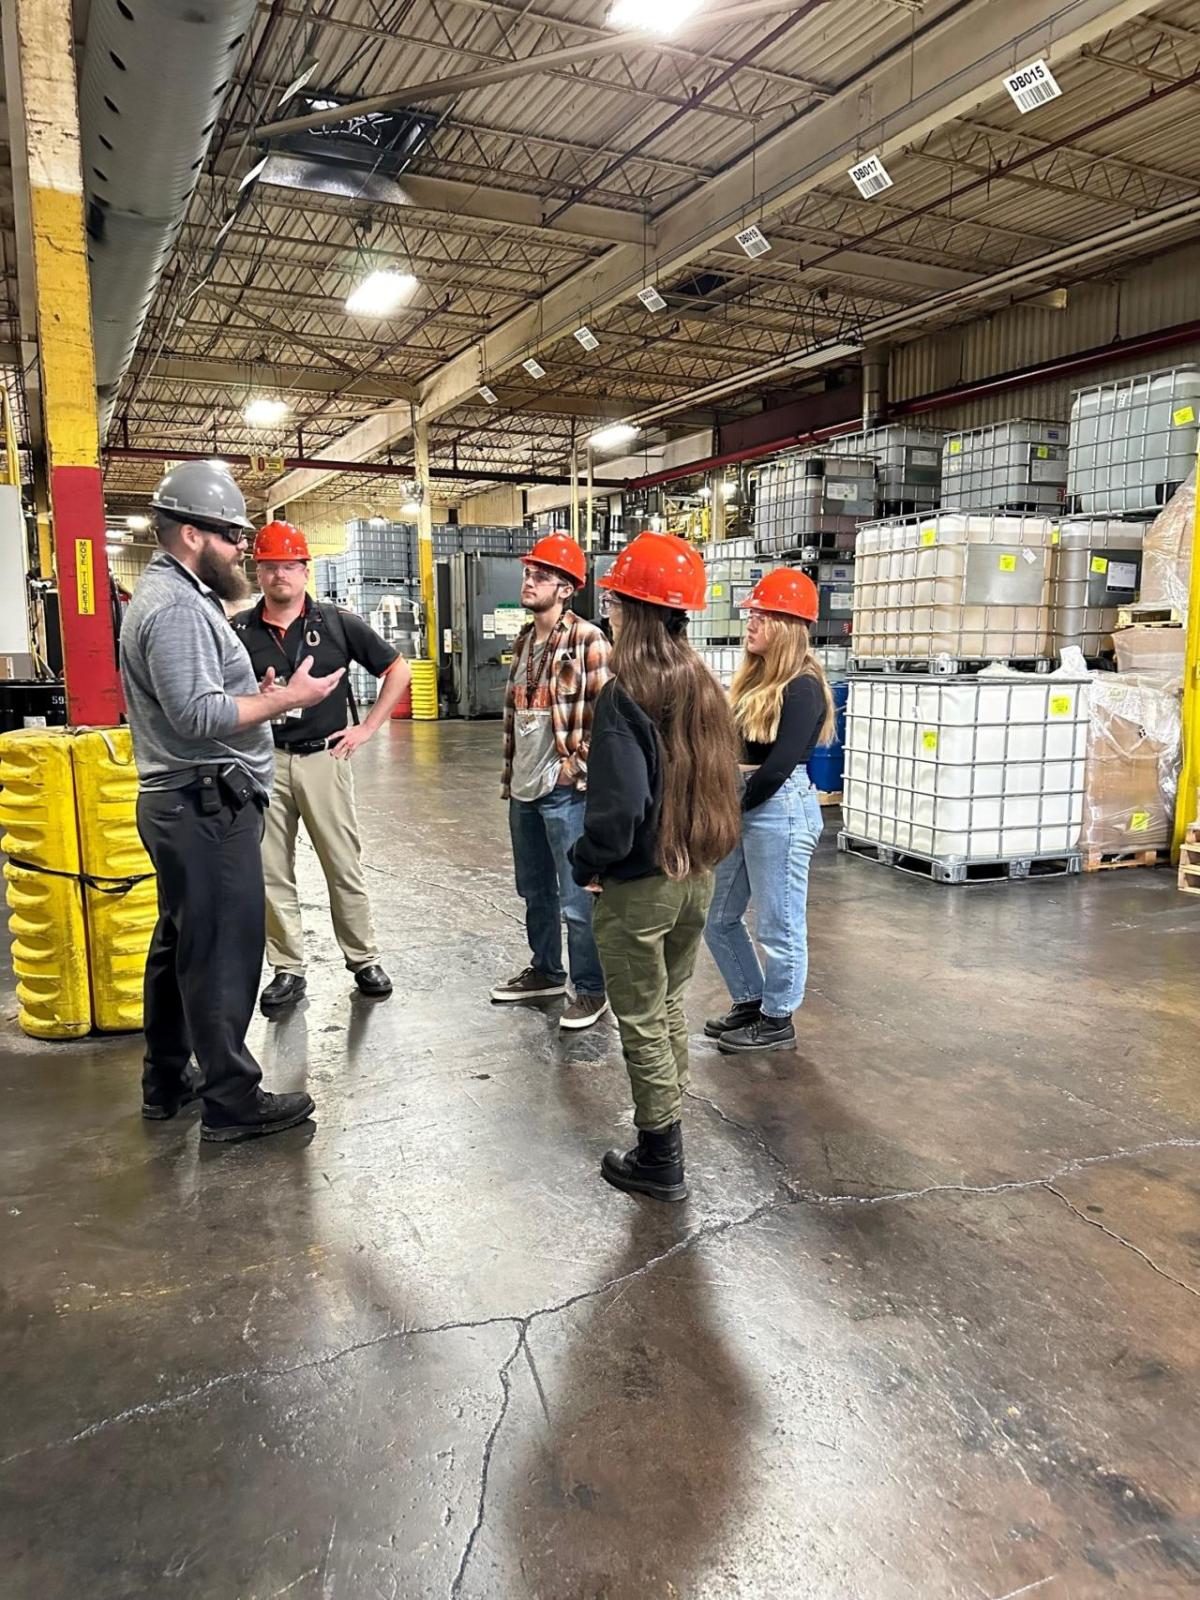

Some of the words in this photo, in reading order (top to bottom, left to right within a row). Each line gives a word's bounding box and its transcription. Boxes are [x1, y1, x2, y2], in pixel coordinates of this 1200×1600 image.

[1009, 65, 1045, 92] DB015
[853, 160, 878, 181] DB017
[81, 571, 89, 613] TICKETS
